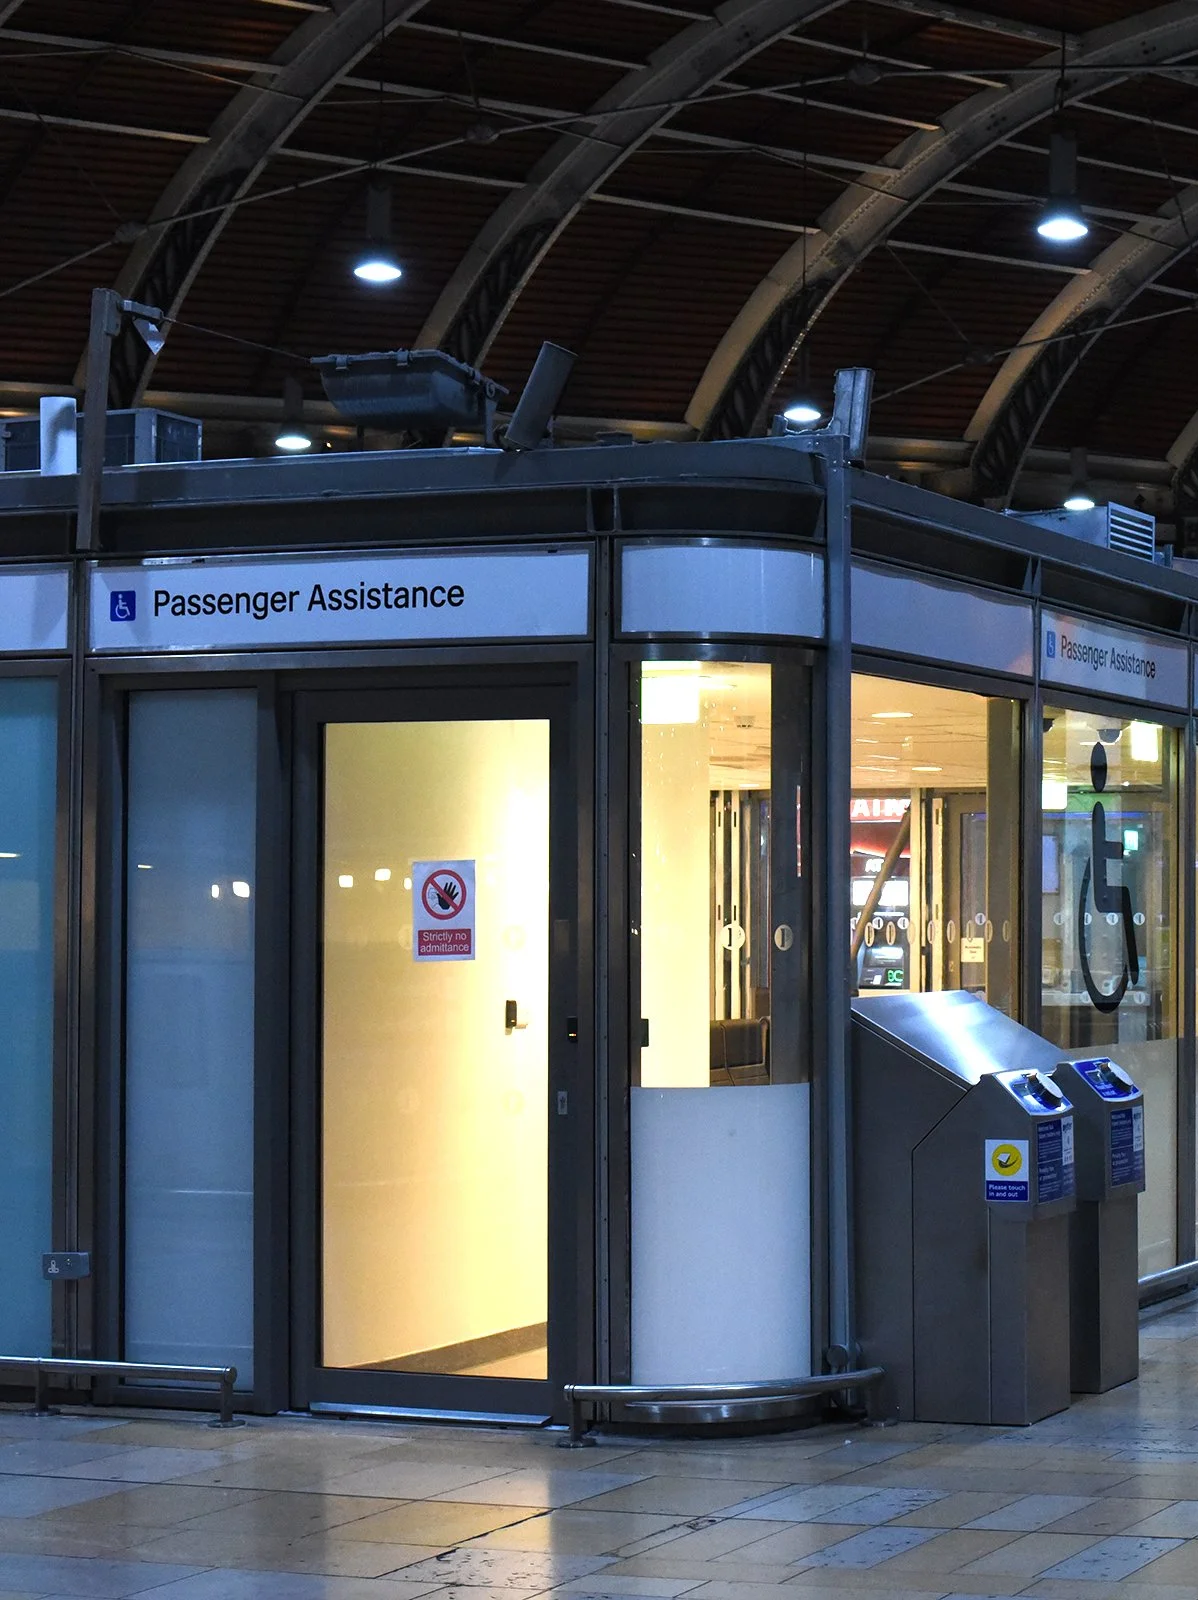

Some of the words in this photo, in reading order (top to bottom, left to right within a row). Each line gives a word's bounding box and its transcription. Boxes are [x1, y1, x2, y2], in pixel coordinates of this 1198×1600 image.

[154, 589, 300, 620] Passenger
[307, 581, 465, 612] Assistance
[1060, 635, 1108, 671] Passenger
[1110, 647, 1156, 679] Assistance
[422, 931, 453, 943] Strictly
[455, 933, 467, 941] no
[420, 942, 469, 953] admittance
[988, 1183, 1007, 1191] Please
[1008, 1183, 1026, 1191] touch
